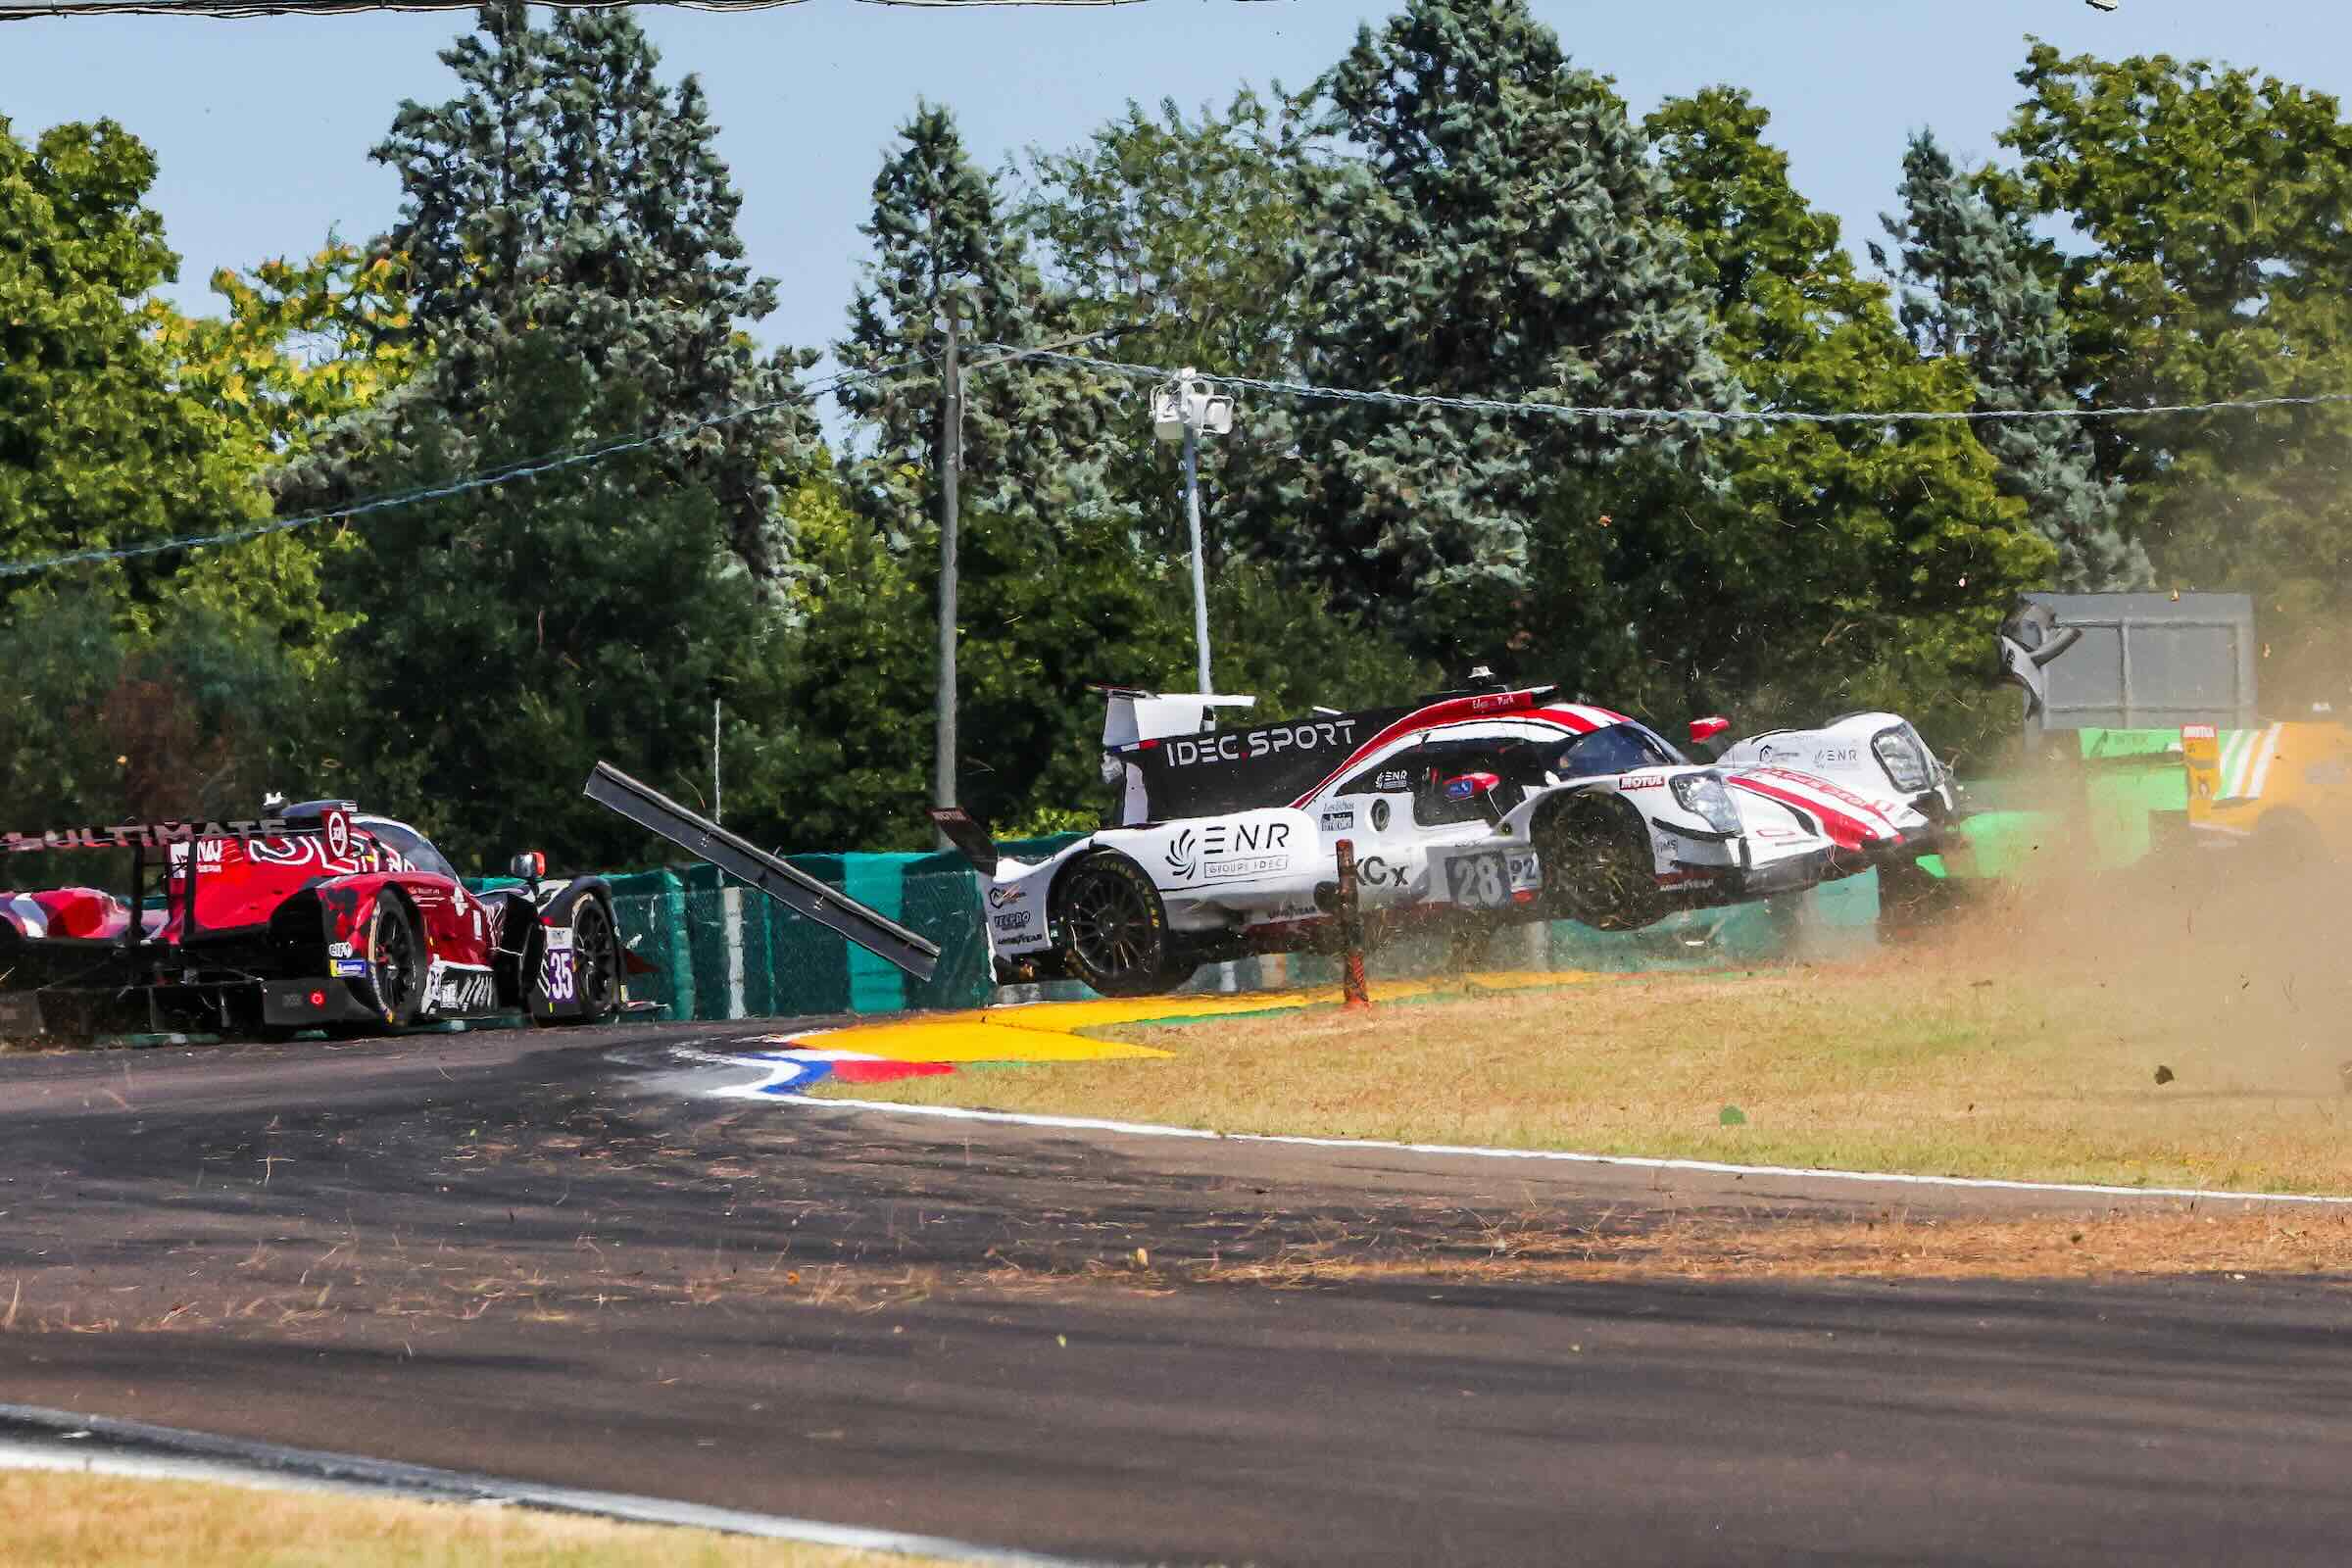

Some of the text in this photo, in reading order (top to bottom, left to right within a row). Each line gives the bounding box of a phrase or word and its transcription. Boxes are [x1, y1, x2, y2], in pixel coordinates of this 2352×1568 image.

[1165, 719, 1355, 766] IDEC SPORT
[1385, 769, 1408, 781] ENR
[1621, 776, 1664, 788] MOTUL
[1203, 823, 1290, 855] ENR
[1253, 859, 1284, 871] IDEC
[1453, 855, 1503, 901] 28
[550, 952, 573, 1000] 35
